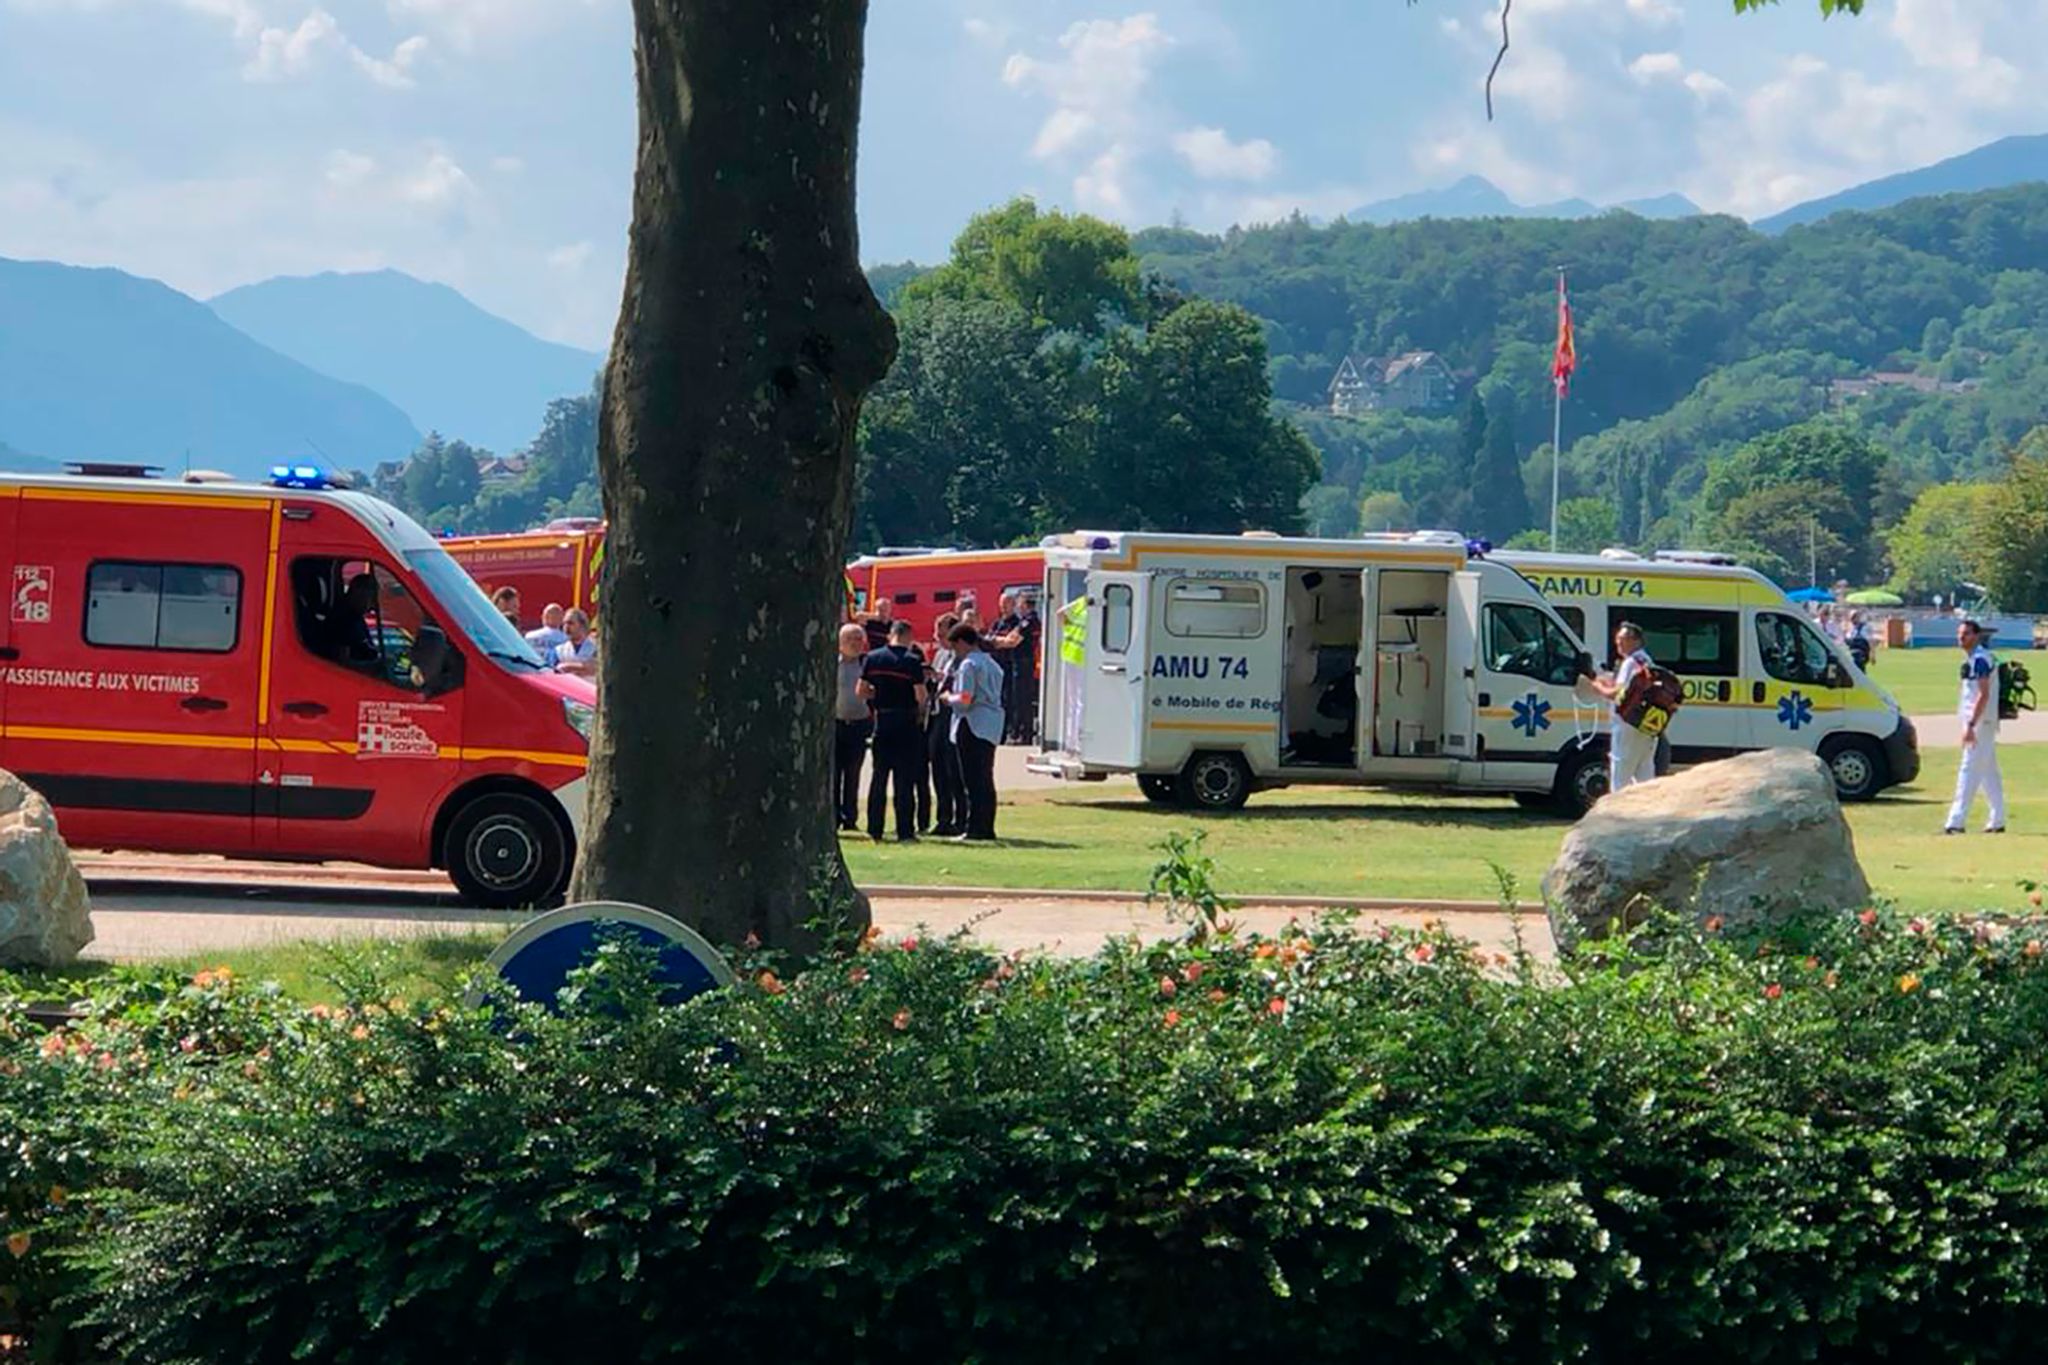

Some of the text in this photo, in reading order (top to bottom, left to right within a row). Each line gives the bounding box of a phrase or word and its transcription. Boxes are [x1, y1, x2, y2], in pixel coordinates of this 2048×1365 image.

[14, 565, 40, 580] 112
[1613, 579, 1645, 598] 74
[20, 601, 49, 621] 18
[1152, 655, 1249, 679] AMU 74
[96, 672, 129, 690] AUX
[132, 674, 200, 693] VICTIMES
[1681, 680, 1717, 700] OIS
[1167, 695, 1220, 708] Mobile
[1225, 697, 1245, 709] de
[1250, 697, 1282, 714] Rég
[384, 725, 423, 741] haute
